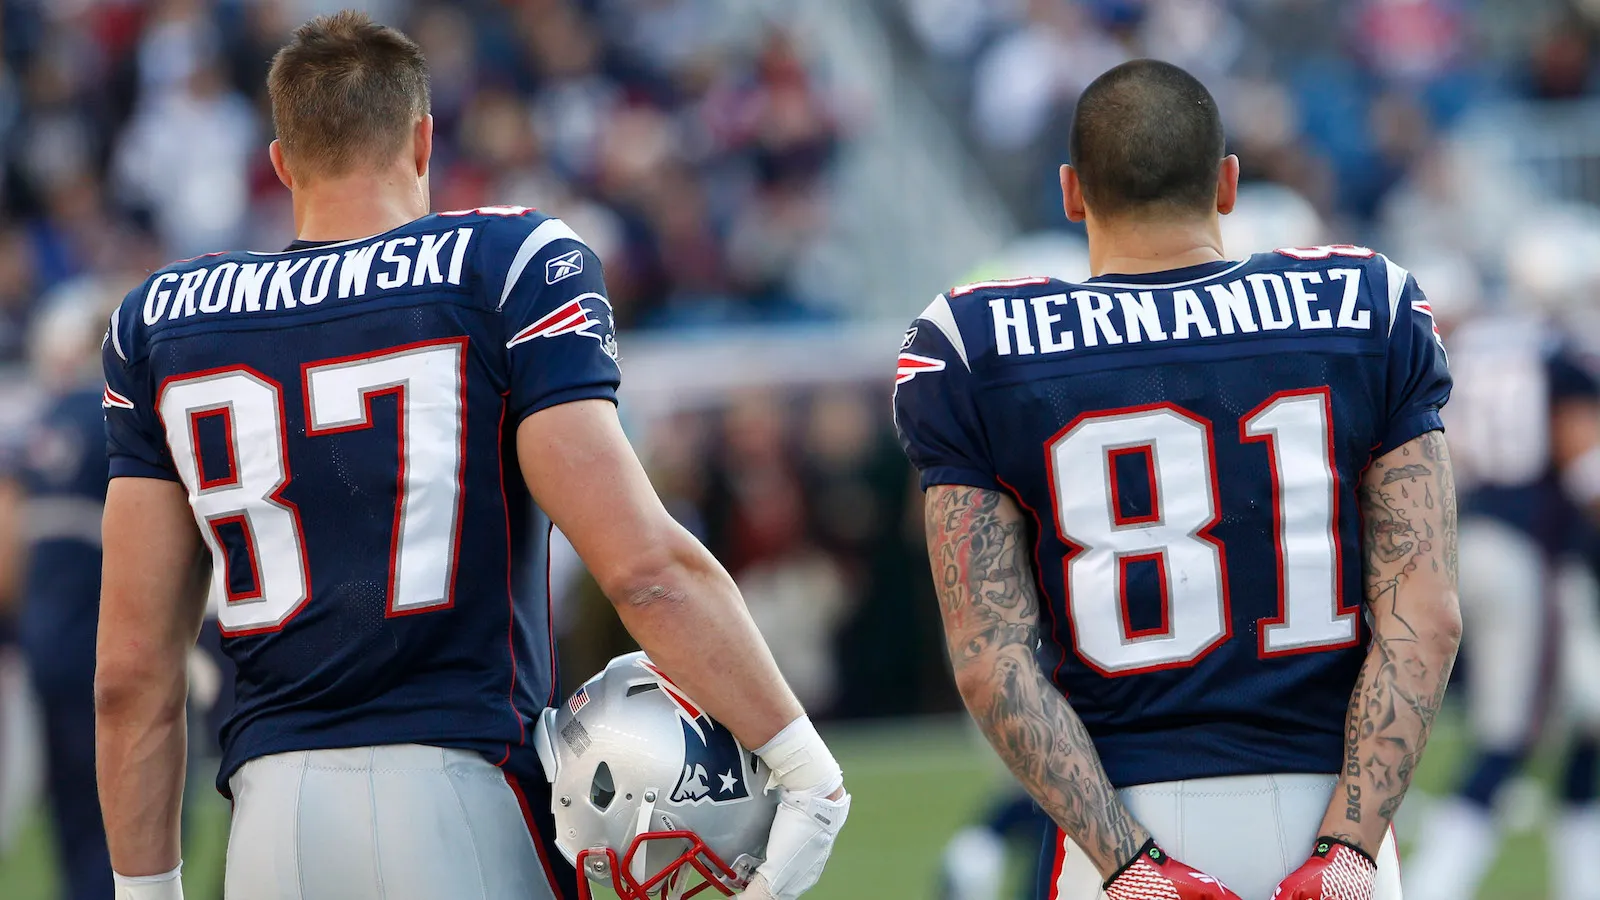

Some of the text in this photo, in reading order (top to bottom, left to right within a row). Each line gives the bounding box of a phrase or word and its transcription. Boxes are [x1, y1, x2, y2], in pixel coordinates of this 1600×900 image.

[142, 227, 474, 327] GRONKOWSKI
[988, 268, 1372, 355] HERNANDEZ
[154, 335, 469, 638] 87
[1043, 385, 1360, 678] 81
[1346, 784, 1362, 824] BIG
